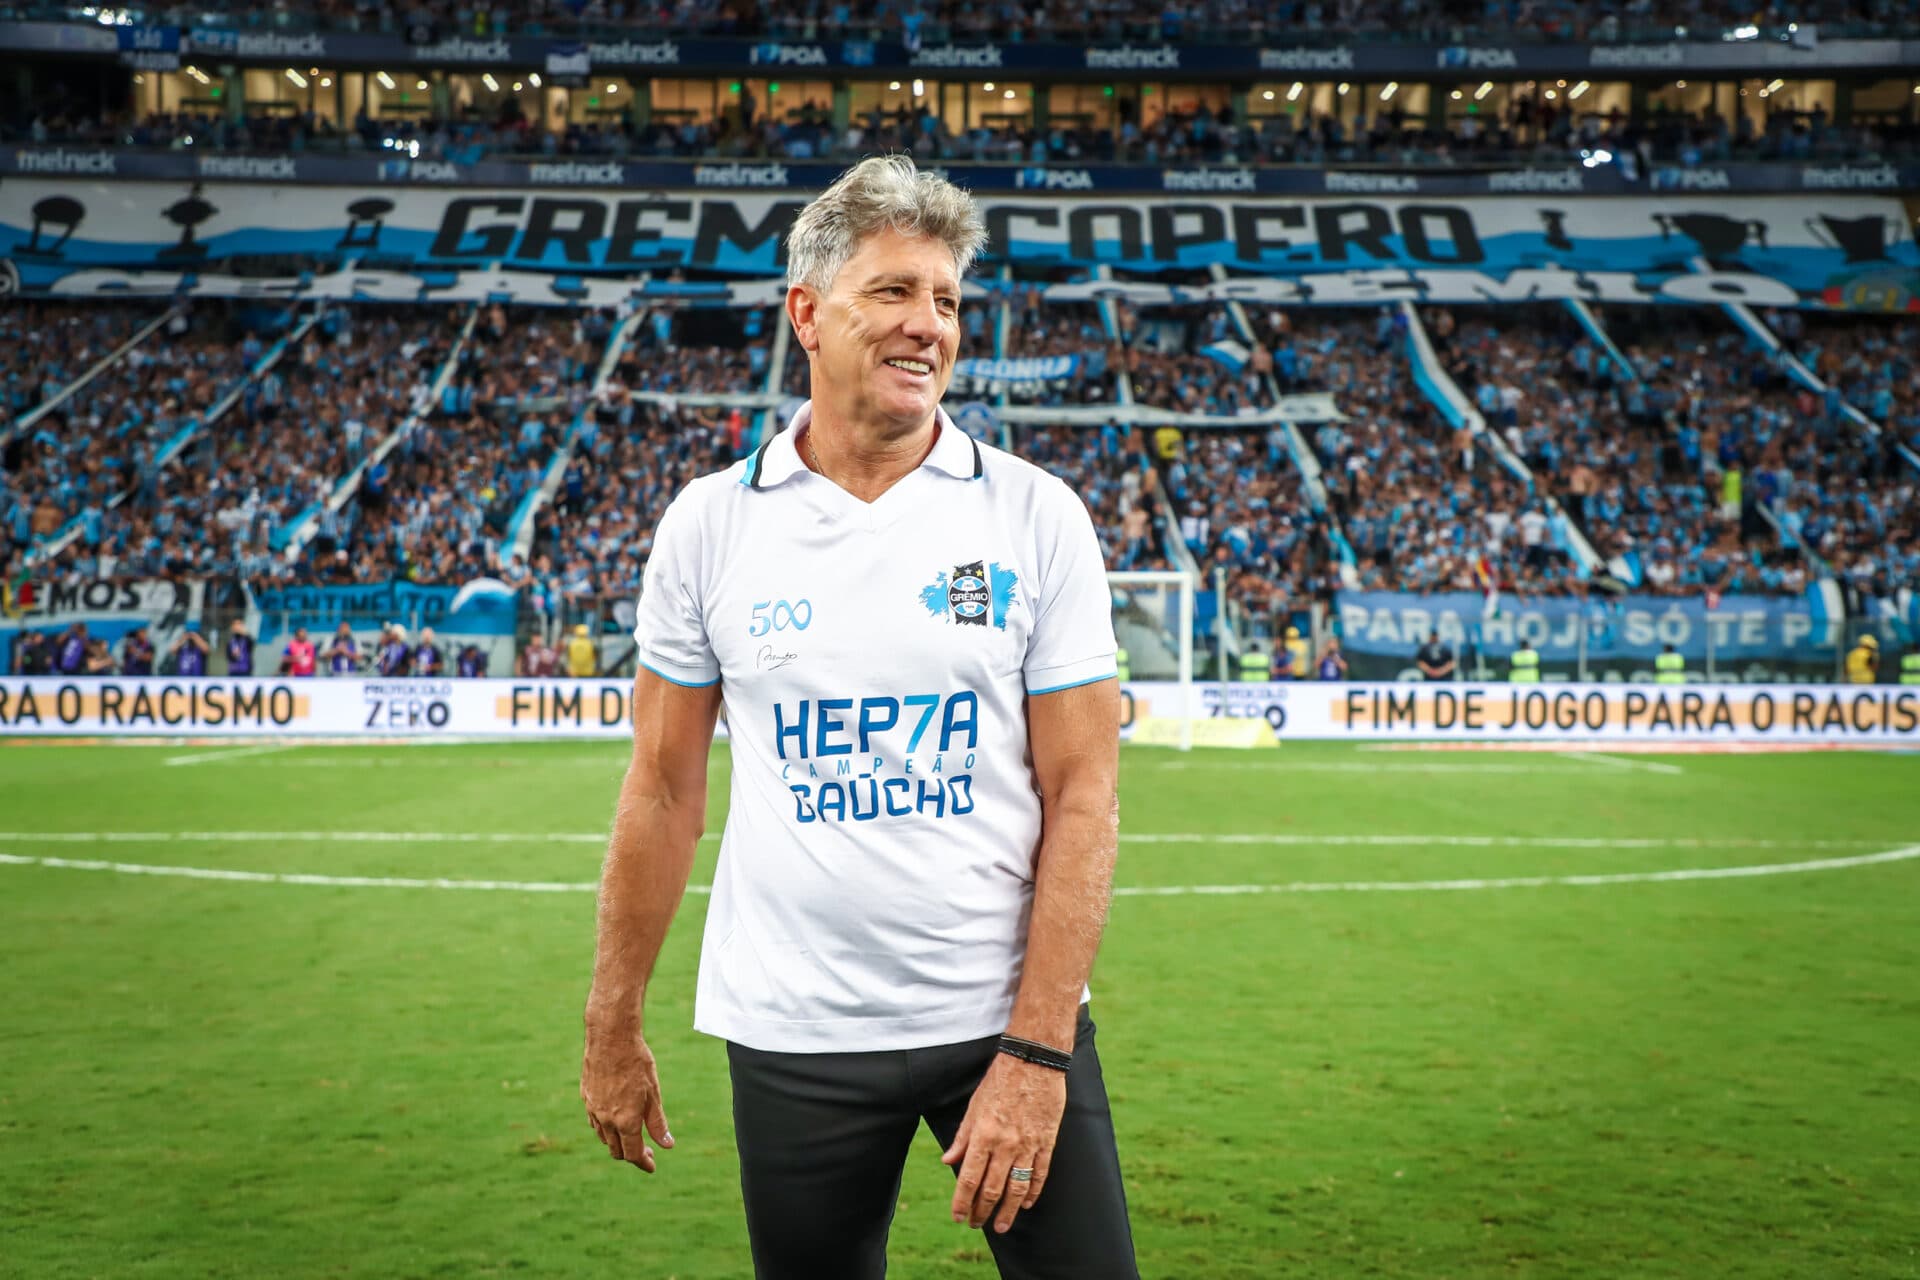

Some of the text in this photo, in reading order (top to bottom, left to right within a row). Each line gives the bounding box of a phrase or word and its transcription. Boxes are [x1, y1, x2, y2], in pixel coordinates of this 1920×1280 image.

[780, 46, 827, 65] POA
[1086, 44, 1179, 68] melnick
[1260, 45, 1353, 69] melnick
[1469, 49, 1517, 68] POA
[1590, 44, 1683, 67] melnick
[17, 147, 116, 172] melnick
[201, 154, 296, 178] melnick
[411, 162, 457, 181] POA
[530, 159, 623, 183] melnick
[695, 161, 788, 185] melnick
[1045, 169, 1094, 189] POA
[1164, 167, 1256, 191] melnick
[1489, 166, 1583, 191] melnick
[1681, 169, 1730, 188] POA
[1802, 164, 1899, 188] melnick
[986, 204, 1485, 265] COPERO
[950, 590, 988, 602] GRÊMIO
[1342, 604, 1465, 643] PARA
[1481, 610, 1580, 648] HOJ
[1624, 603, 1691, 646] SÓ
[1704, 610, 1767, 646] TE
[56, 684, 83, 725] O
[101, 684, 294, 726] RACISMO
[366, 700, 449, 728] ZERO
[511, 685, 635, 727] FIM D
[1346, 690, 1920, 733] FIM DE JOGO PARA O RACIS
[773, 690, 979, 760] HEP7A
[781, 752, 976, 780] CAMPEÃO
[789, 772, 975, 823] GAÚCHO
